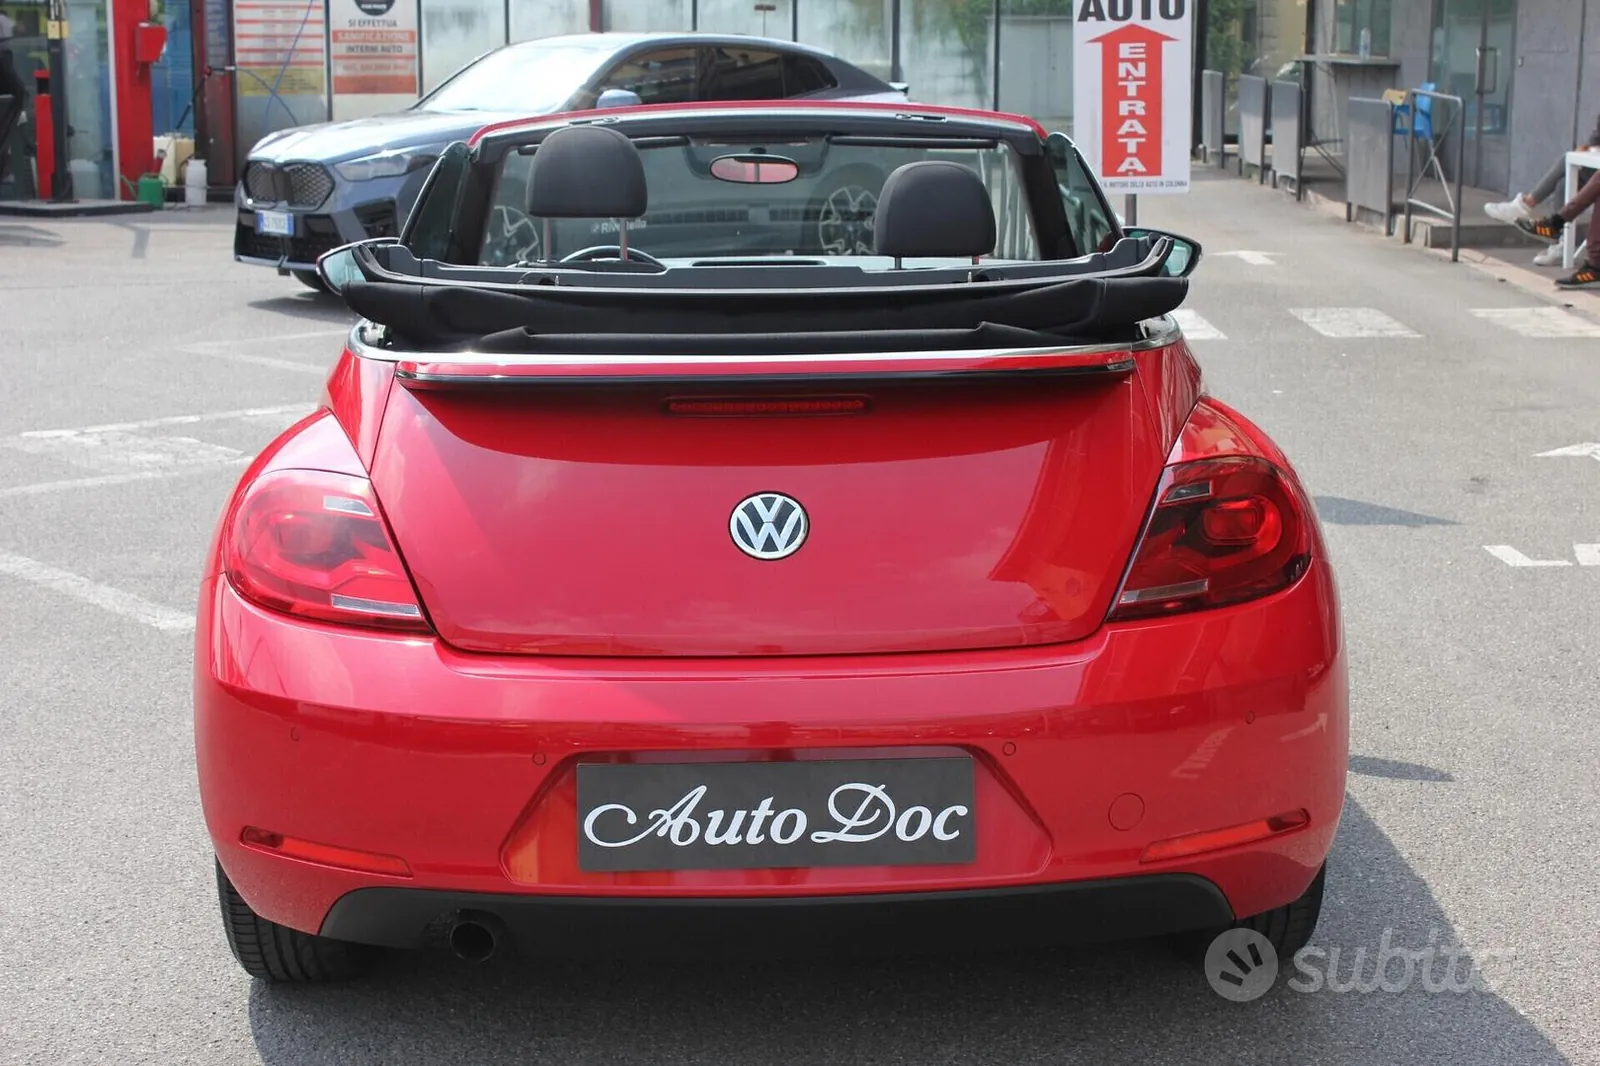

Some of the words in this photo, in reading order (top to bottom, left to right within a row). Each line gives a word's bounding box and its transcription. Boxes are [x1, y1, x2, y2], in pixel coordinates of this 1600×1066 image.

[348, 19, 356, 28] SI
[358, 19, 398, 28] EFFETTUA
[1077, 0, 1185, 22] AUTO
[346, 45, 379, 53] INTERNI
[380, 45, 403, 53] AUTO
[1117, 42, 1147, 174] ENTRATA
[732, 493, 806, 558] VW
[583, 784, 808, 848] Auto
[811, 782, 969, 844] Doc
